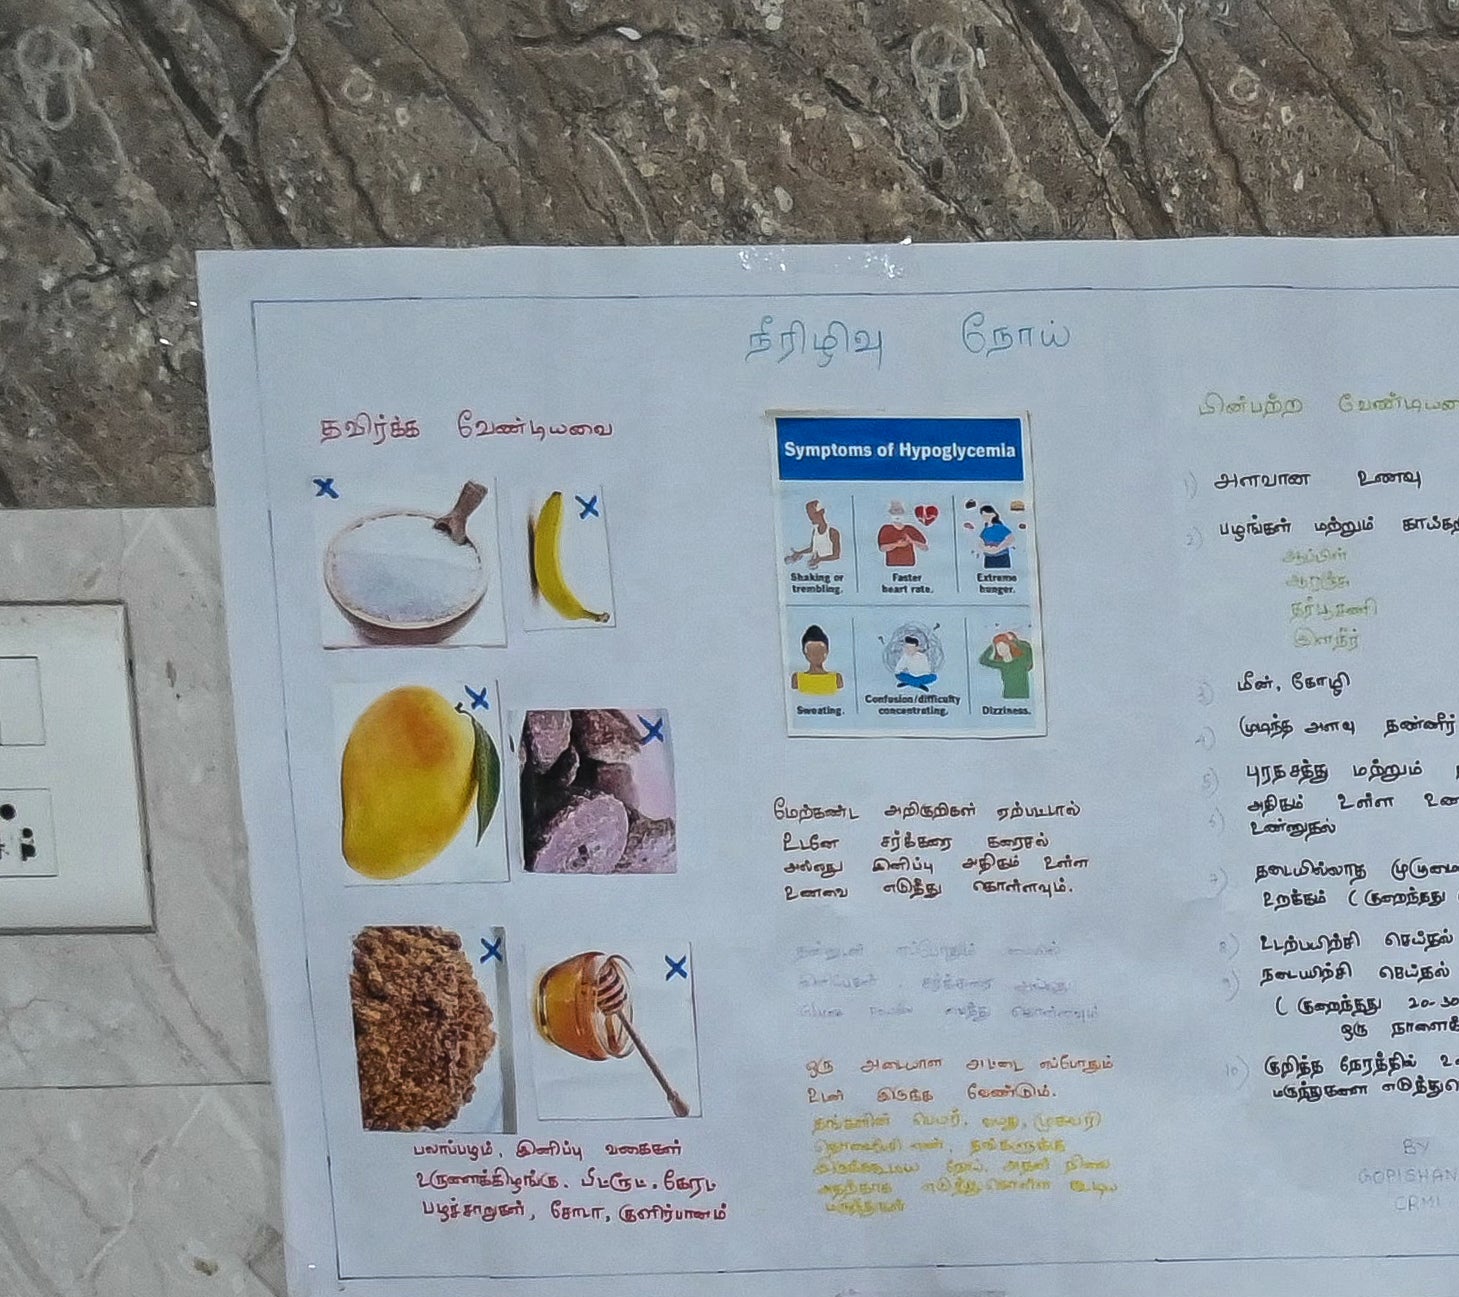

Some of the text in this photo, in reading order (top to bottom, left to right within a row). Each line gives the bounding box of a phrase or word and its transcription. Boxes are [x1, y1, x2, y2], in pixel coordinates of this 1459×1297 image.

[745, 311, 1070, 371] நீரிழிவு நோய்
[320, 409, 613, 445] தவிர்க்க வேண்டியவை
[784, 441, 1016, 461] Symptoms of Hypoglycemia
[1213, 470, 1422, 489] அளவான உணவு
[1219, 515, 1292, 542] பழங்கள்
[1314, 516, 1375, 538] மற்றும்
[791, 573, 830, 583] Shaking
[892, 573, 922, 583] Faster
[977, 573, 1017, 583] Extreme
[792, 584, 843, 595] trembling.
[979, 585, 1015, 595] hunger.
[1292, 672, 1351, 697] கோழி
[865, 694, 961, 706] Confusion/difficulty
[797, 706, 845, 716] Sweating.
[878, 706, 948, 717] concentrating.
[982, 706, 1031, 716] Dizziness.
[1304, 719, 1356, 736] அளவு
[1384, 713, 1455, 738] தண்ணீர்
[1353, 759, 1423, 782] மற்றும்
[884, 801, 976, 821] அறிகுறிகள்
[1247, 793, 1395, 817] அதிகம் உள்ள
[783, 831, 839, 851] உடனே
[880, 830, 952, 852] சர்க்கரை
[872, 857, 934, 875] இனிப்பு
[962, 853, 1020, 873] அதிகம்
[1043, 855, 1089, 870] உள்ள
[1341, 1020, 1368, 1041] ஒரு
[805, 1059, 834, 1078] ஒரு
[516, 1139, 682, 1160] இனிப்பு வகைகள்
